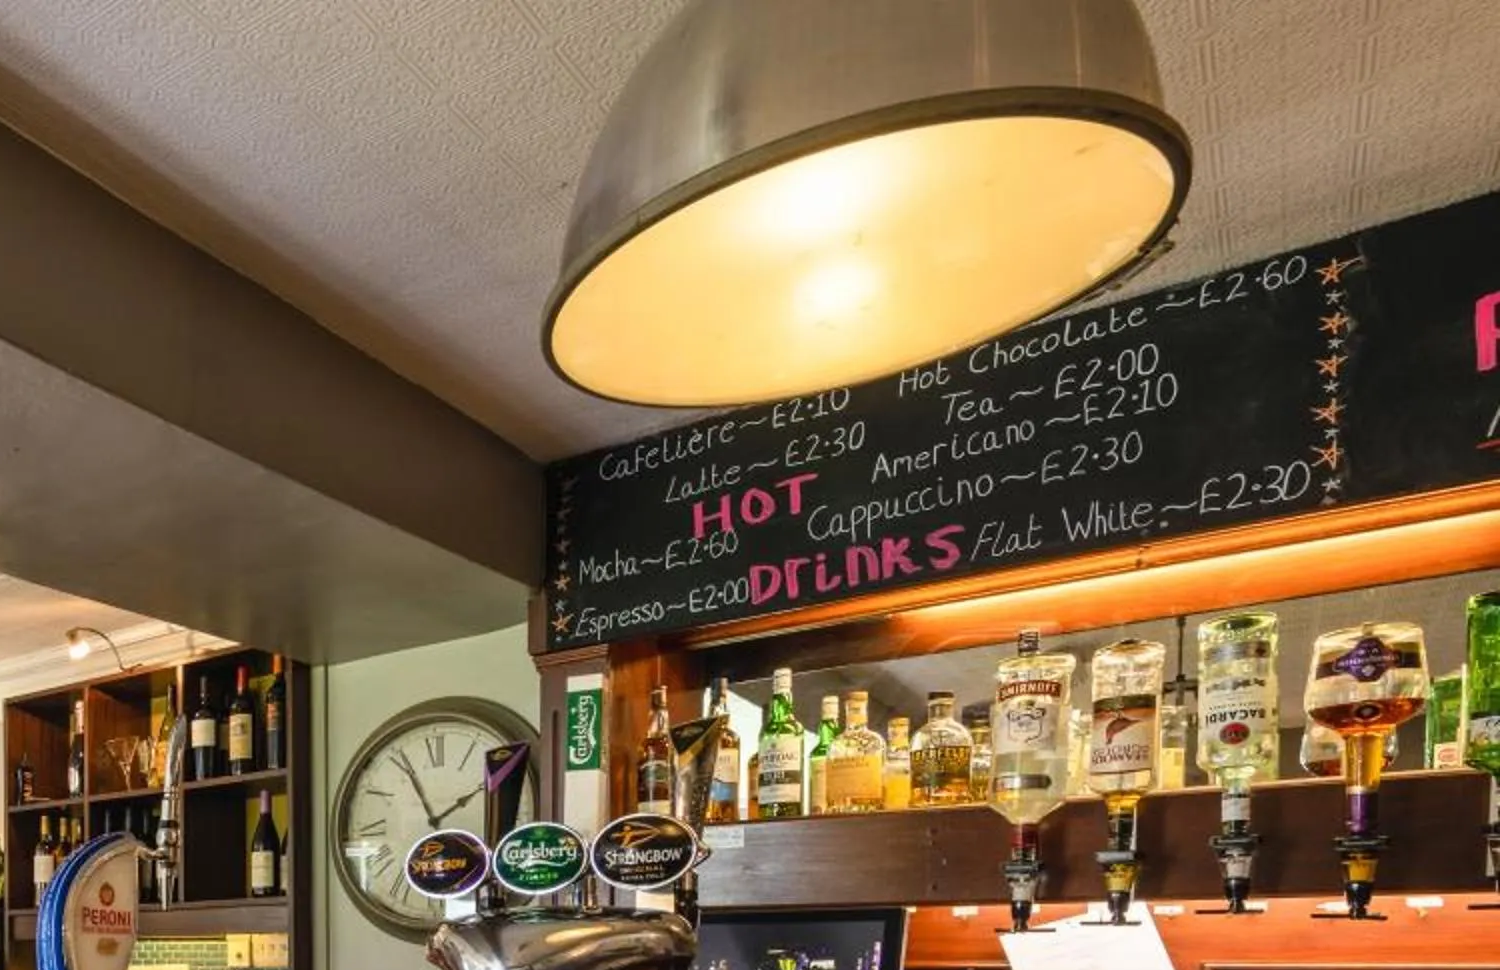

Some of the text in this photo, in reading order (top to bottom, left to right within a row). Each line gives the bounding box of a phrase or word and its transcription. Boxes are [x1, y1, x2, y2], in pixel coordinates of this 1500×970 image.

[899, 360, 951, 397] Hot
[968, 304, 1148, 376] Chocolate
[941, 389, 1004, 426] Tea
[871, 417, 1035, 484] Americano
[664, 455, 742, 502] Latte
[691, 473, 819, 538] HOT
[807, 473, 993, 542] Cappuccino
[970, 513, 1043, 562] Flat
[579, 550, 640, 585] Mocha
[573, 604, 665, 641] Espresso
[569, 694, 596, 766] Carlsberg
[502, 838, 578, 868] Carlsberg
[604, 847, 683, 869] STRONGBOW
[82, 906, 132, 927] PERONI
